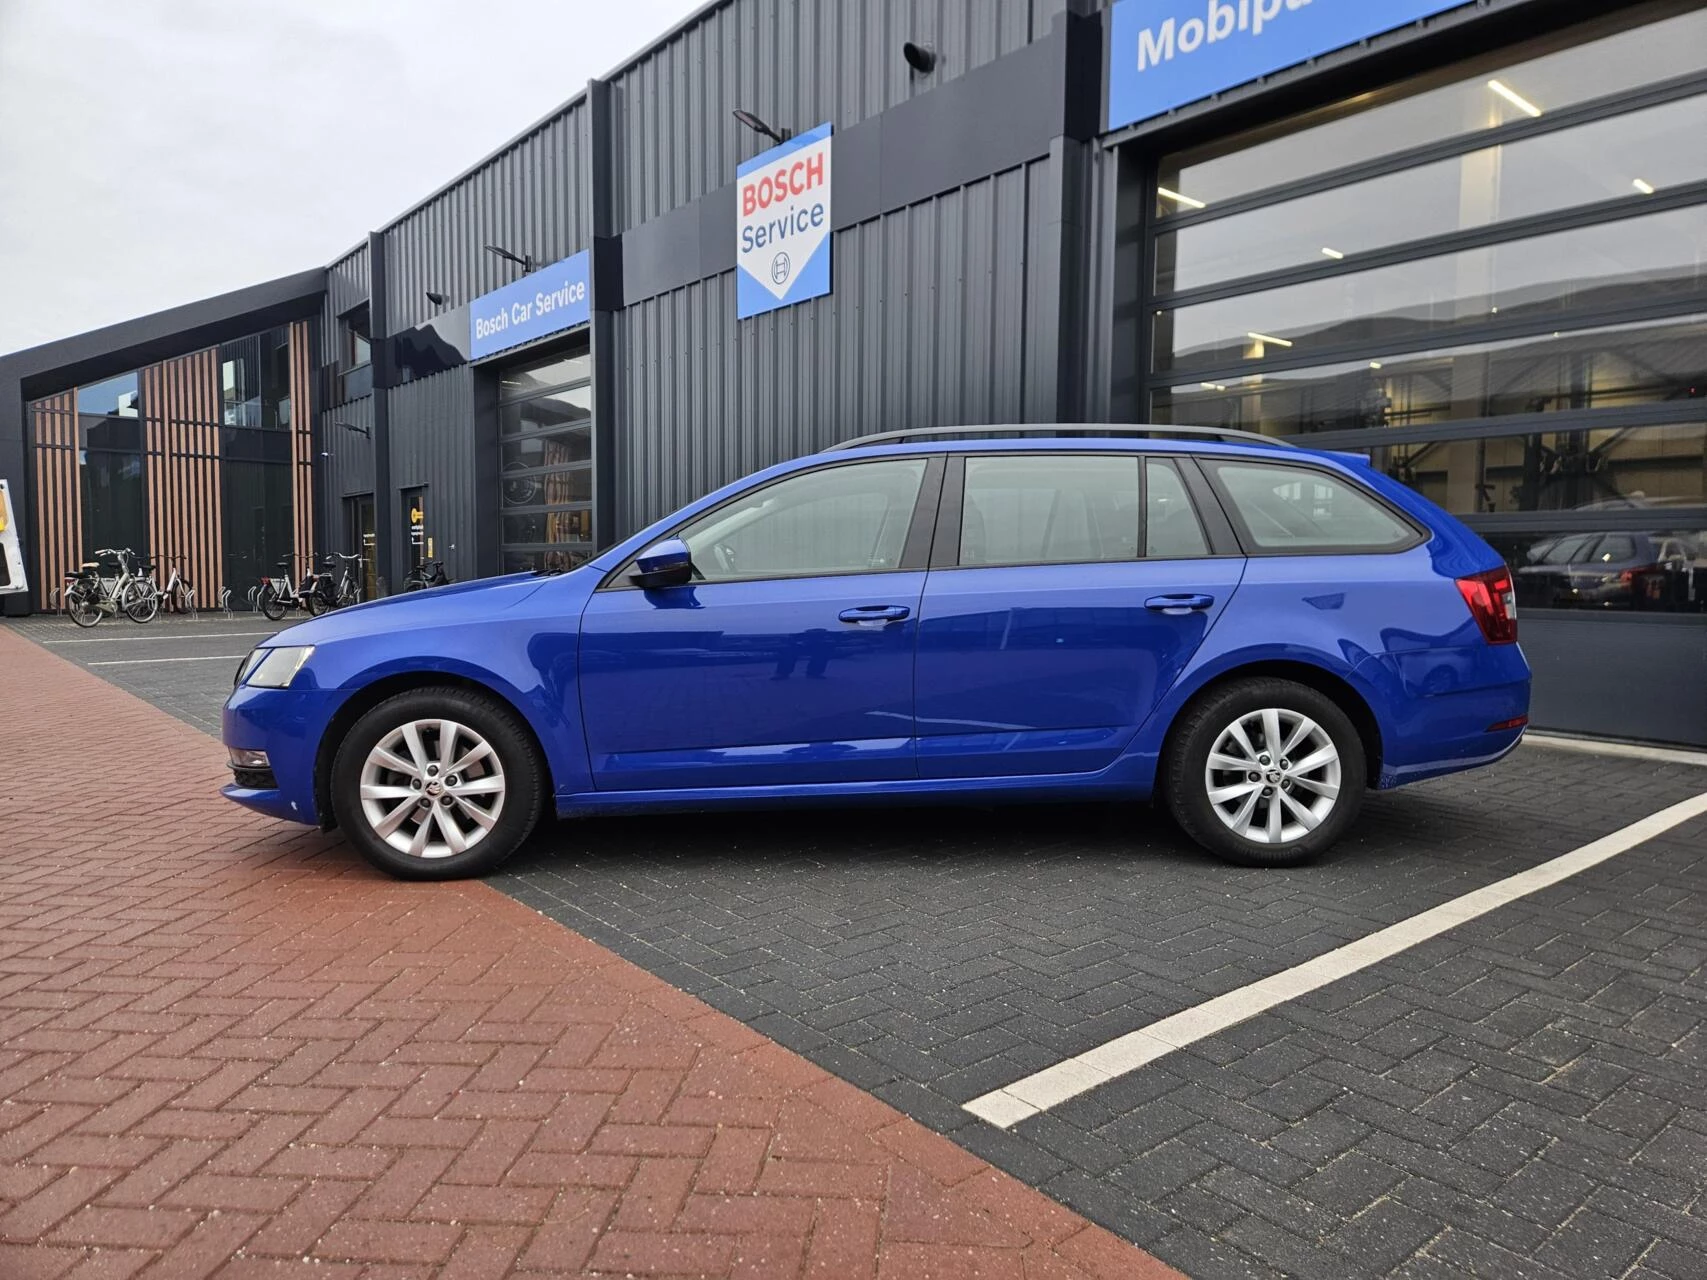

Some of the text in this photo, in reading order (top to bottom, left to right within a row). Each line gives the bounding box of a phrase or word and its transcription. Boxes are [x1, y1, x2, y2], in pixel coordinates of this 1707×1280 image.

[1137, 0, 1313, 72] Mobip
[743, 152, 824, 217] BOSCH
[741, 203, 824, 254] Service
[476, 281, 585, 340] Bosch Car Service
